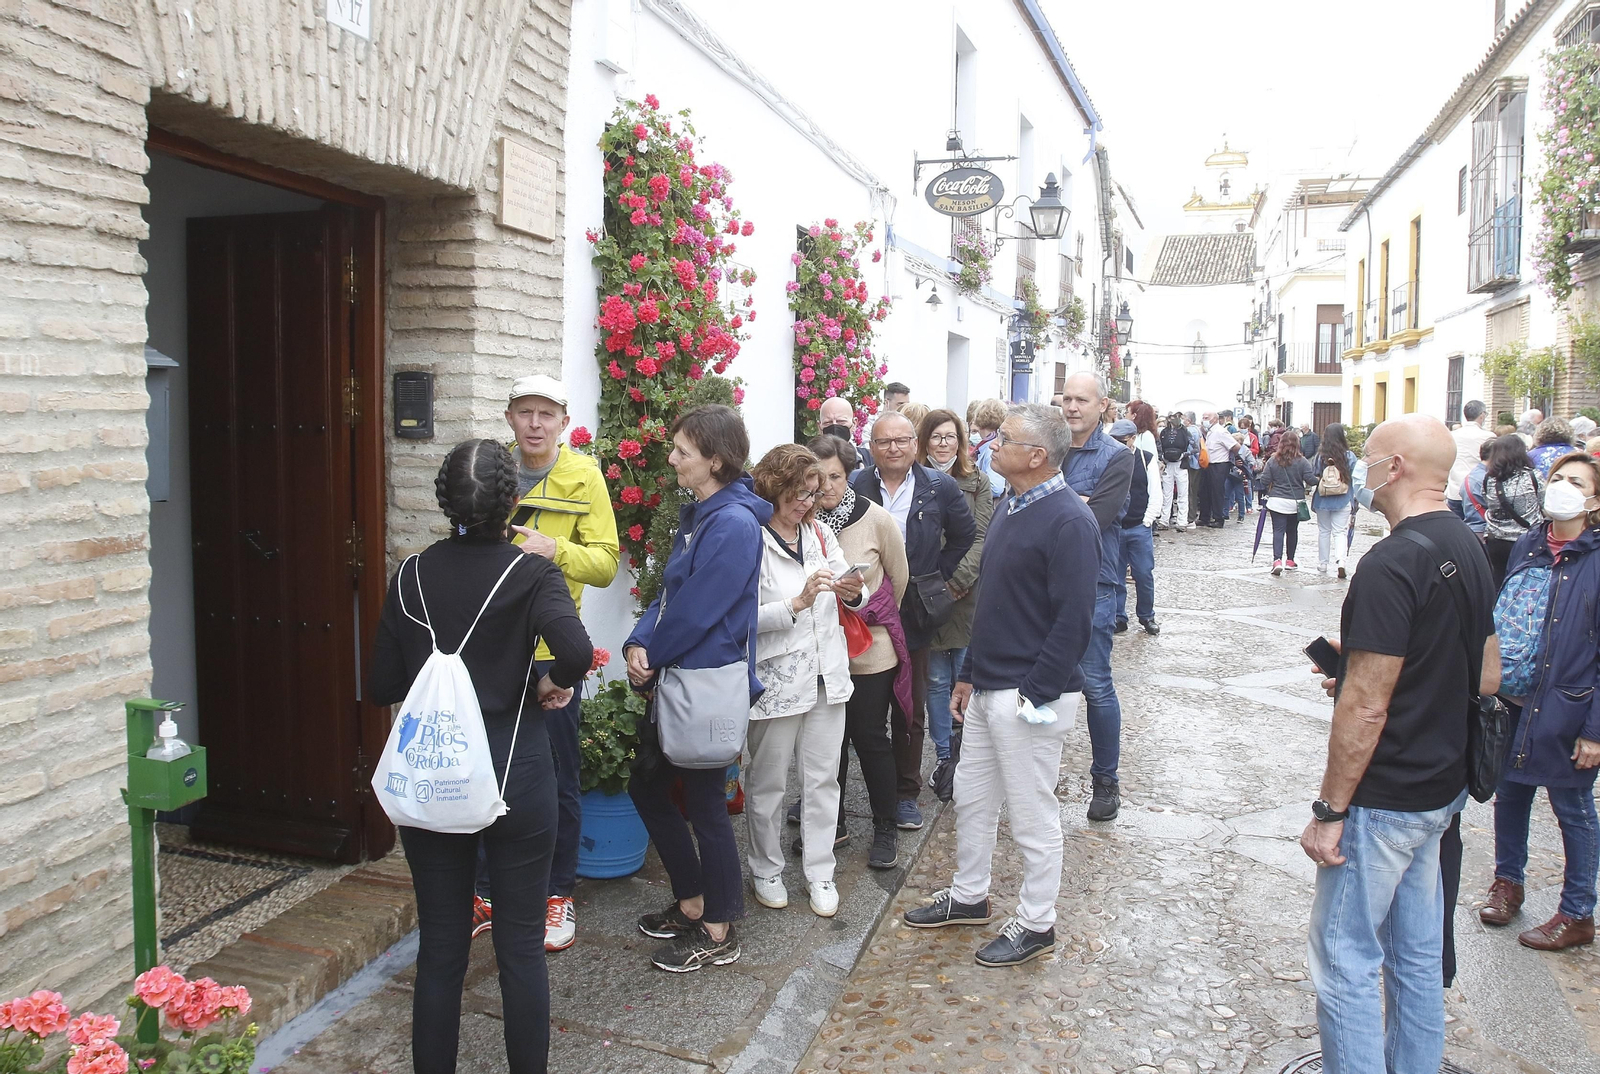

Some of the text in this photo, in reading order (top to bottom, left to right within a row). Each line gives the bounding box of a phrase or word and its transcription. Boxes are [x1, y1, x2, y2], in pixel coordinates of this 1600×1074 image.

[939, 202, 989, 212] SAN BASILIO
[434, 778, 470, 786] Patrimonio
[436, 793, 469, 802] Inmaterial
